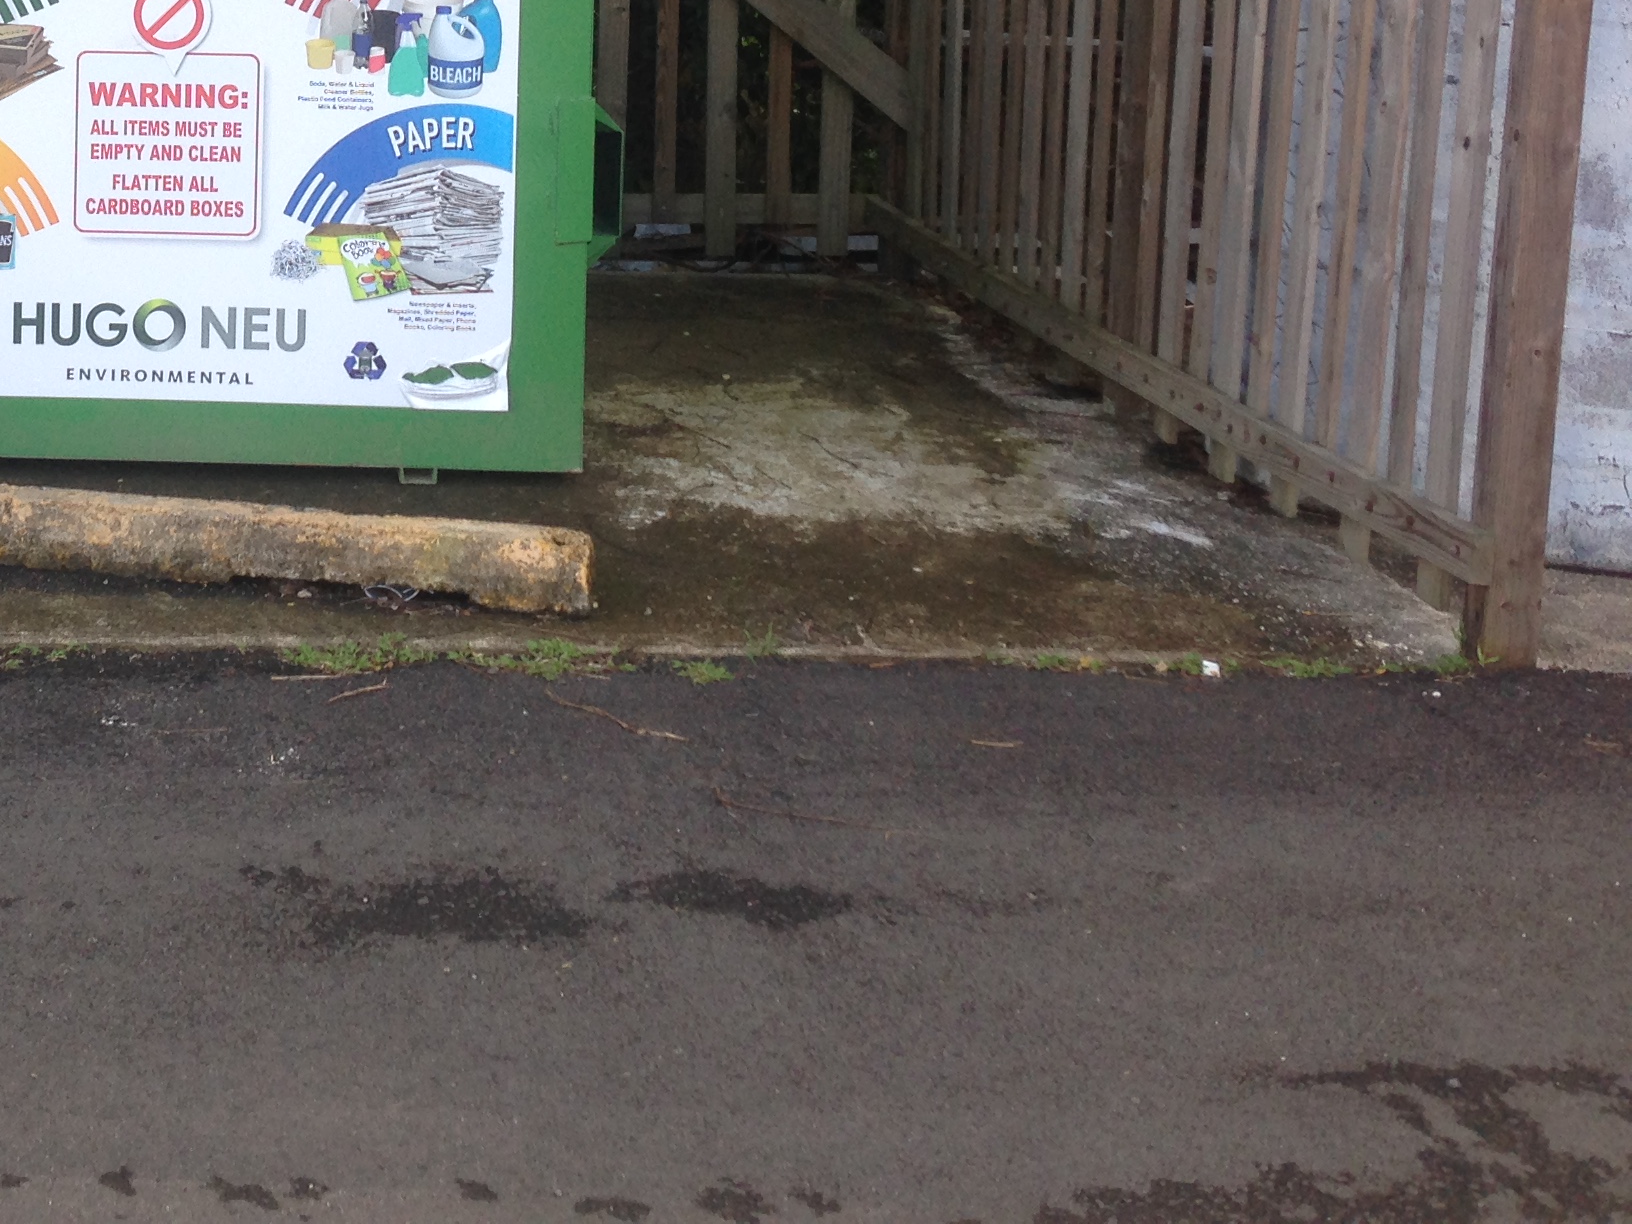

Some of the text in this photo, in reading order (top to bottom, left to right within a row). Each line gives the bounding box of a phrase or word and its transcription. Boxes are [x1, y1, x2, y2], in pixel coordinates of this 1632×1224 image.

[430, 65, 482, 83] BLEACH
[88, 81, 249, 109] WARNING:
[90, 119, 243, 138] ALL ITEMS MUST BE
[387, 116, 475, 158] PAPER
[90, 143, 242, 163] EMPTY AND CLEAN
[112, 173, 219, 193] FLATTEN ALL
[85, 197, 244, 218] CARDBOARD BOXES
[12, 298, 307, 352] HUGO NEU
[66, 367, 254, 385] ENVIRONMENTAL
